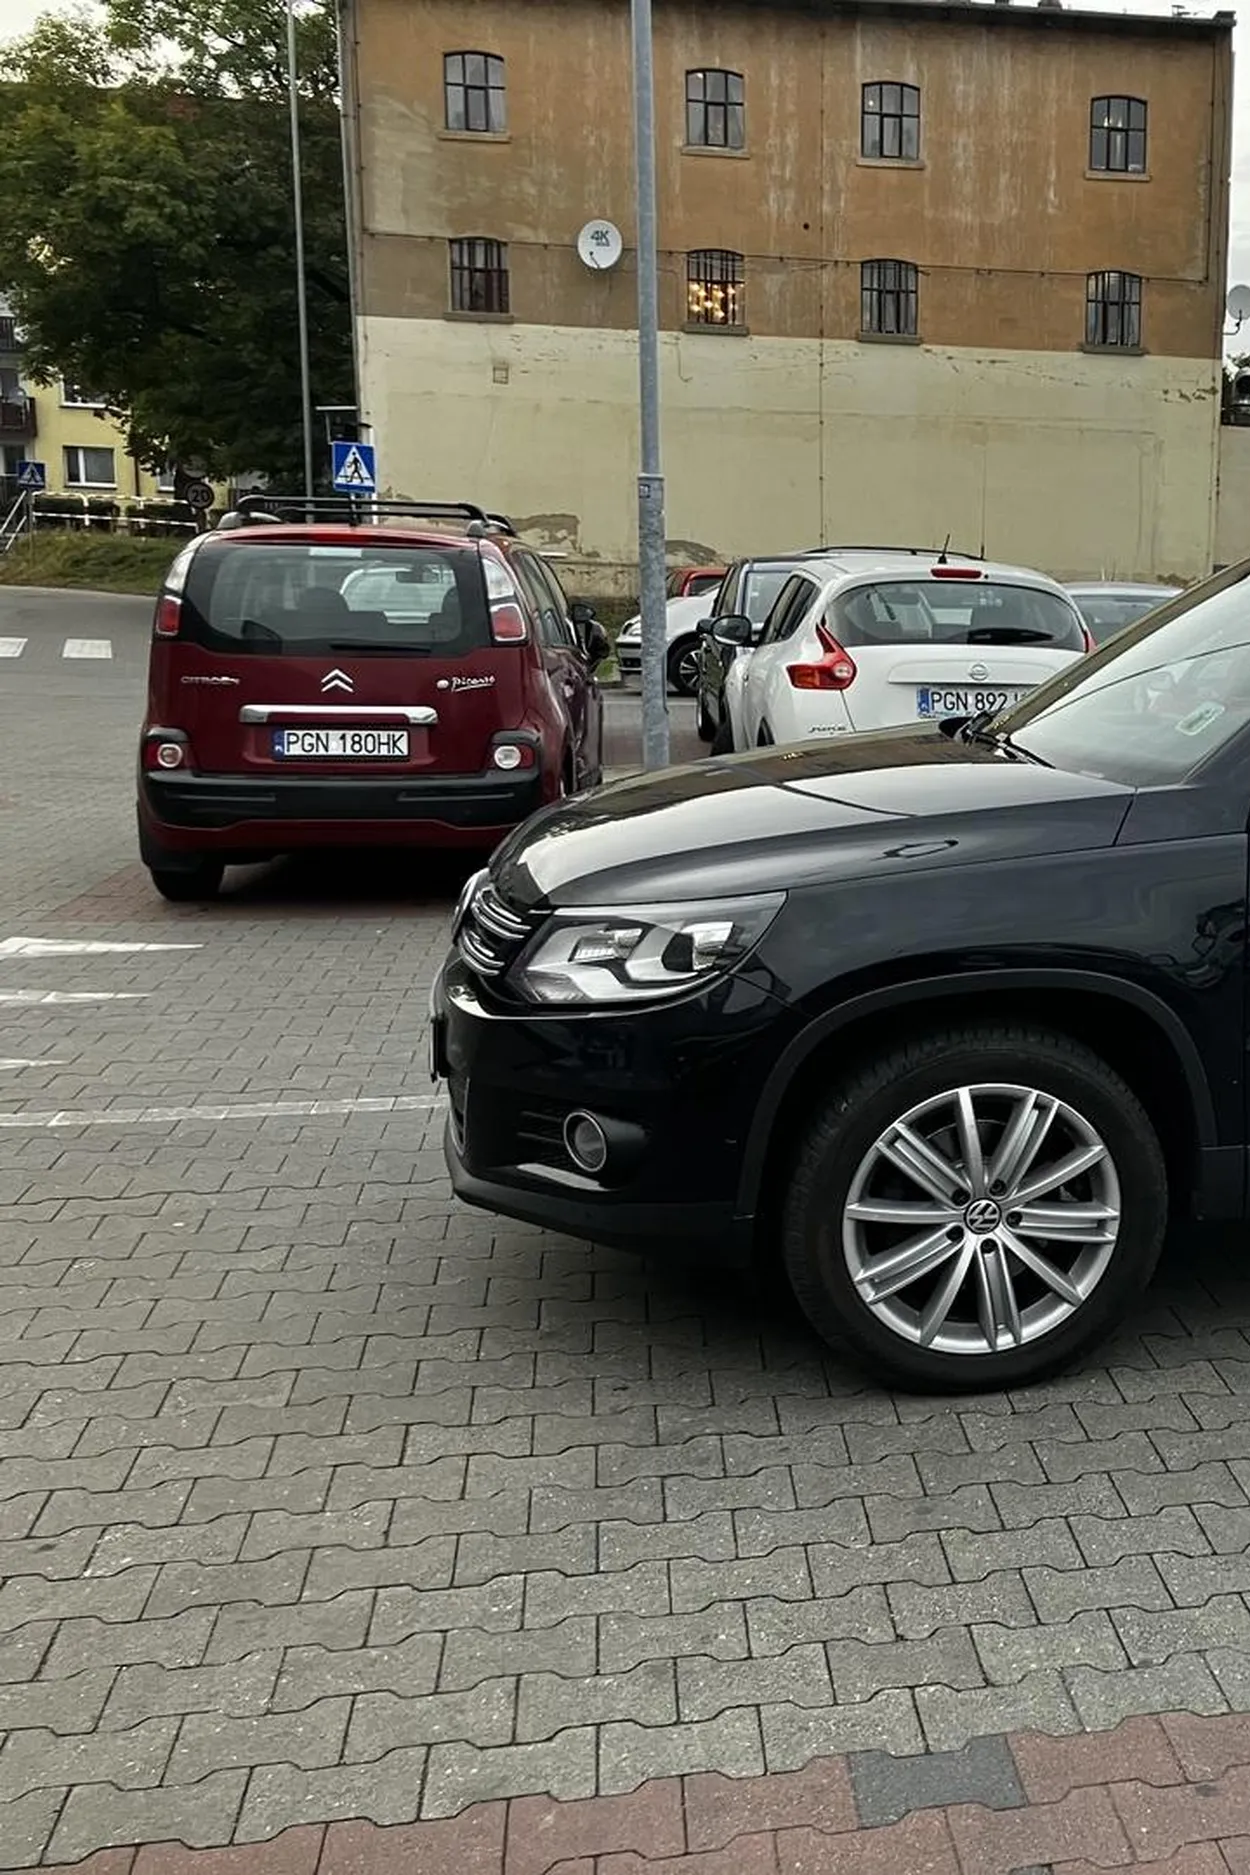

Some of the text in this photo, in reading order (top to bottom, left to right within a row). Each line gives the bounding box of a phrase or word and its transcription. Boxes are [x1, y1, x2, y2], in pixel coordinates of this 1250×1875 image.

[930, 692, 1024, 711] PGN 892
[286, 732, 405, 754] PGN 180HK
